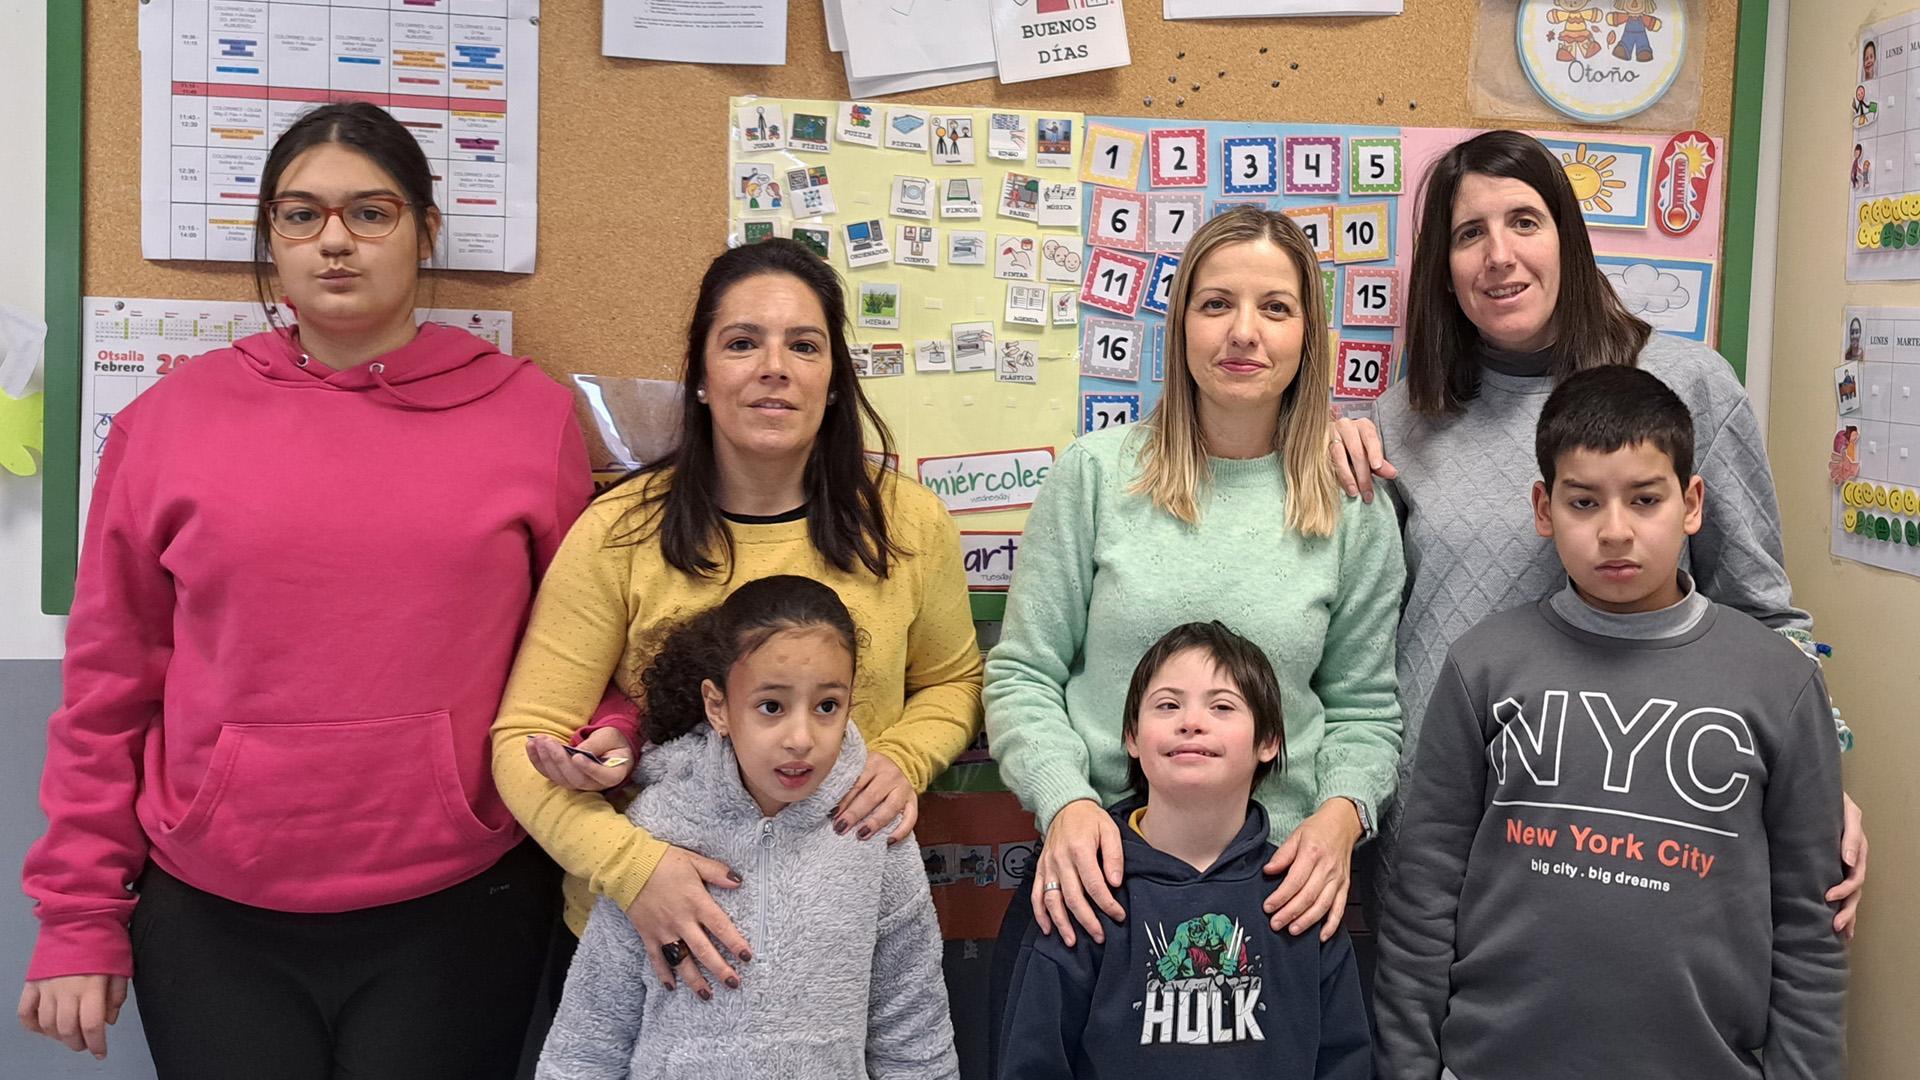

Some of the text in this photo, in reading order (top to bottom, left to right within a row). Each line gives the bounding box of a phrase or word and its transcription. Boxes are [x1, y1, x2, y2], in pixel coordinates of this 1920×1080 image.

[1021, 16, 1097, 39] BUENOS
[1038, 44, 1089, 65] DÍAS
[1885, 46, 1904, 59] LUNES
[1568, 60, 1640, 83] Otoño
[843, 129, 873, 140] PUZZLE
[891, 140, 922, 149] PISCINA
[1105, 145, 1119, 170] 1
[1173, 146, 1188, 171] 2
[1243, 154, 1258, 179] 3
[1304, 154, 1321, 178] 4
[1370, 154, 1385, 179] 5
[1110, 208, 1129, 233] 6
[1169, 210, 1186, 234] 7
[1303, 223, 1318, 247] 9
[1345, 221, 1374, 245] 10
[850, 248, 889, 260] ORDENADOR
[904, 256, 930, 264] CUENTO
[1101, 269, 1129, 296] 11
[1357, 284, 1387, 309] 15
[1097, 334, 1129, 361] 16
[1870, 336, 1889, 346] LUNES
[94, 361, 145, 373] Febrero
[97, 350, 145, 362] Otsaila
[1349, 358, 1379, 384] 20
[925, 458, 1049, 496] miércoles
[1490, 690, 1755, 812] NYC
[1506, 818, 1715, 878] New York City
[1531, 858, 1550, 875] big
[1553, 861, 1578, 879] city
[1588, 866, 1612, 885] big
[1615, 871, 1671, 892] dreams
[1140, 979, 1266, 1045] HULK
